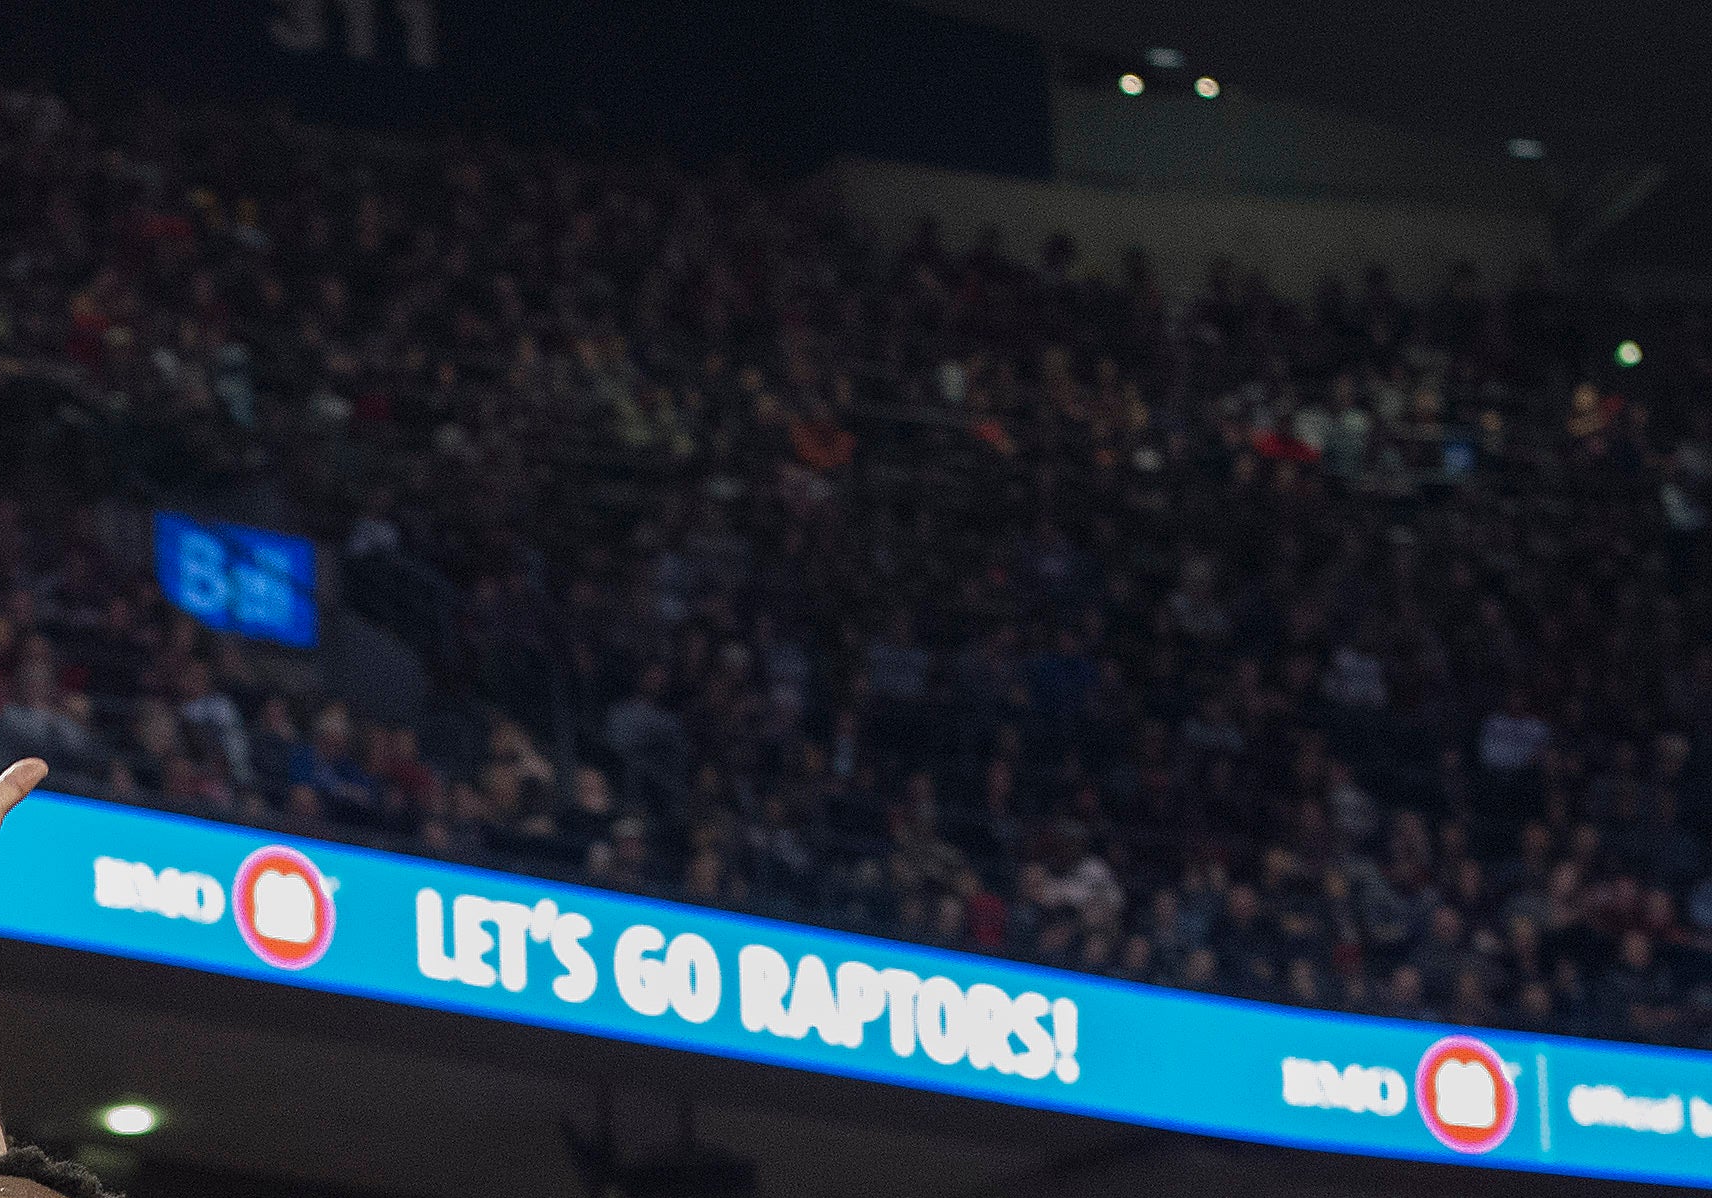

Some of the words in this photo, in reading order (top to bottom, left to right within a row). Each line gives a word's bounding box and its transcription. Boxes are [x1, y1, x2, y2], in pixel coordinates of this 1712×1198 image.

[415, 888, 598, 1003] LET'S
[613, 924, 722, 1024] GO
[738, 944, 1080, 1084] RAPTORS!
